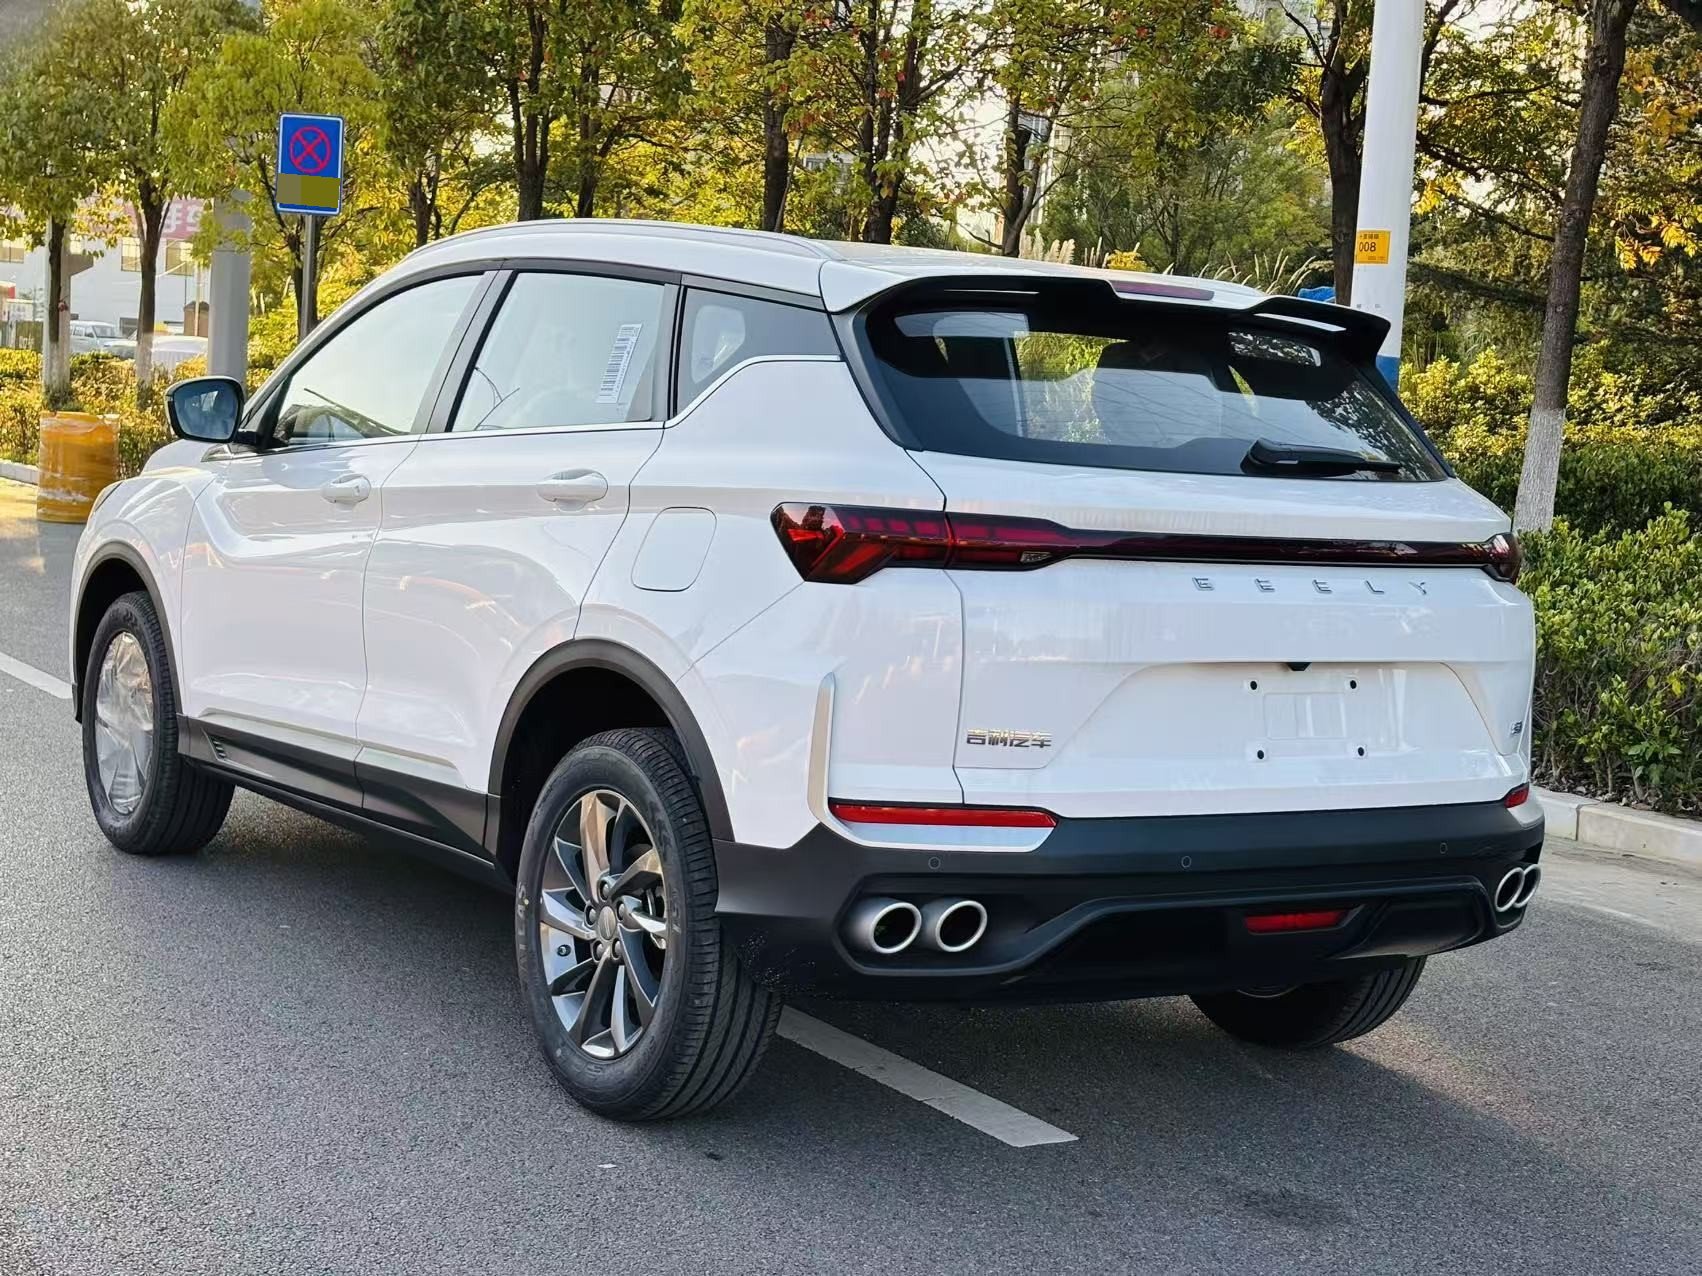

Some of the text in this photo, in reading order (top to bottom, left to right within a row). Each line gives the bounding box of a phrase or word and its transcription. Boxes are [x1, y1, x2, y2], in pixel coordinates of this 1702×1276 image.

[1359, 241, 1377, 253] 008
[966, 729, 1052, 749] 吉利汽车
